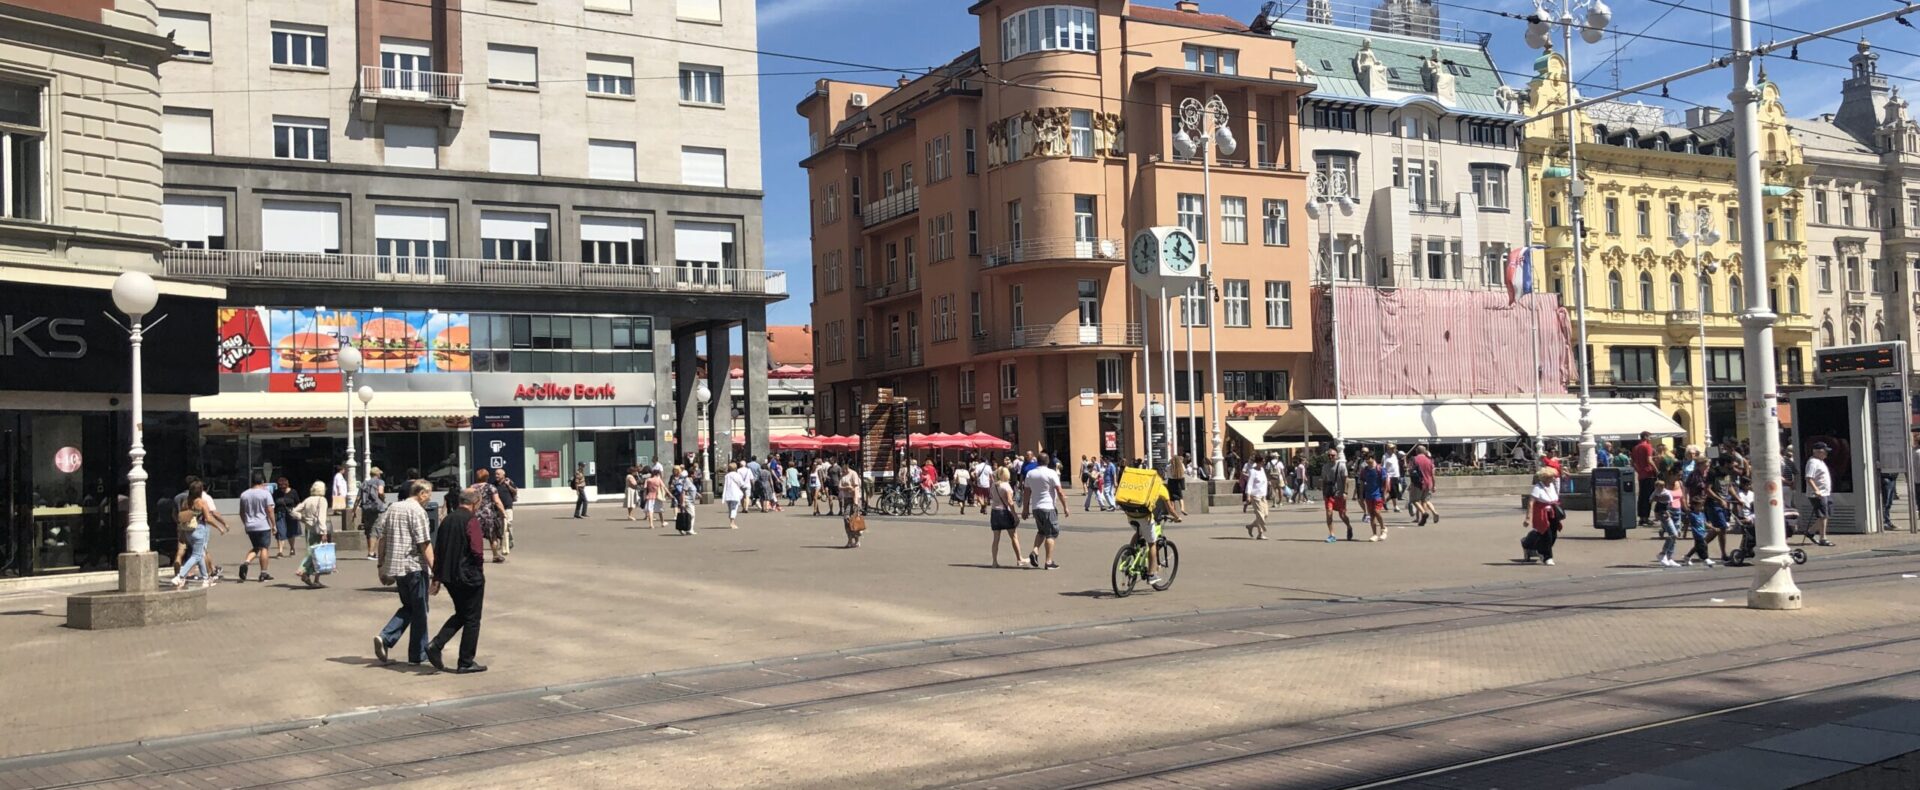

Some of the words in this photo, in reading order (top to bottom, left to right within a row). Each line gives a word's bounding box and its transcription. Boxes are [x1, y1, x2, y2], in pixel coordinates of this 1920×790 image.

[0, 314, 87, 358] KS
[514, 383, 572, 400] Addiko
[574, 383, 616, 400] Bank
